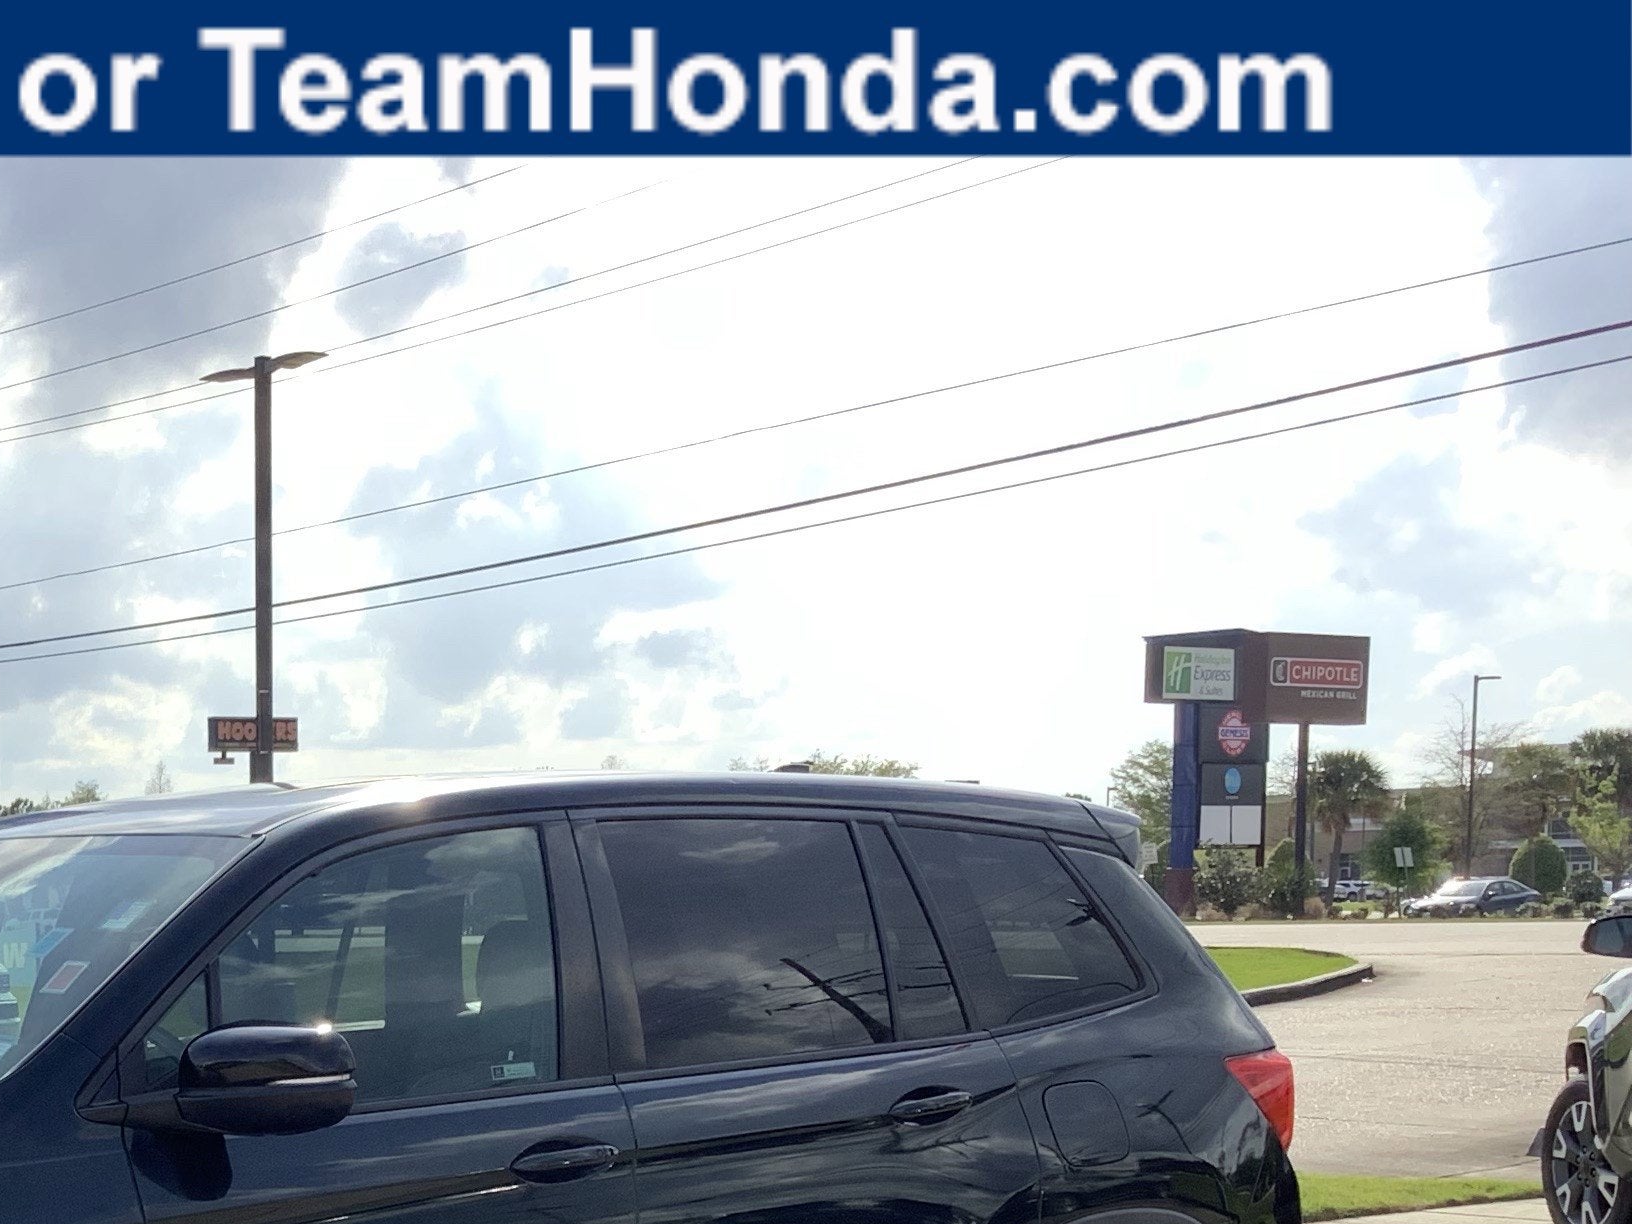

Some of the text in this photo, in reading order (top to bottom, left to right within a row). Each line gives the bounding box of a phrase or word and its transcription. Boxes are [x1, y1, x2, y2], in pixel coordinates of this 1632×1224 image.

[1193, 665, 1232, 682] Express
[1291, 665, 1360, 682] CHIPOTLE
[1300, 690, 1335, 699] MEXICAN
[218, 720, 297, 742] HOORS
